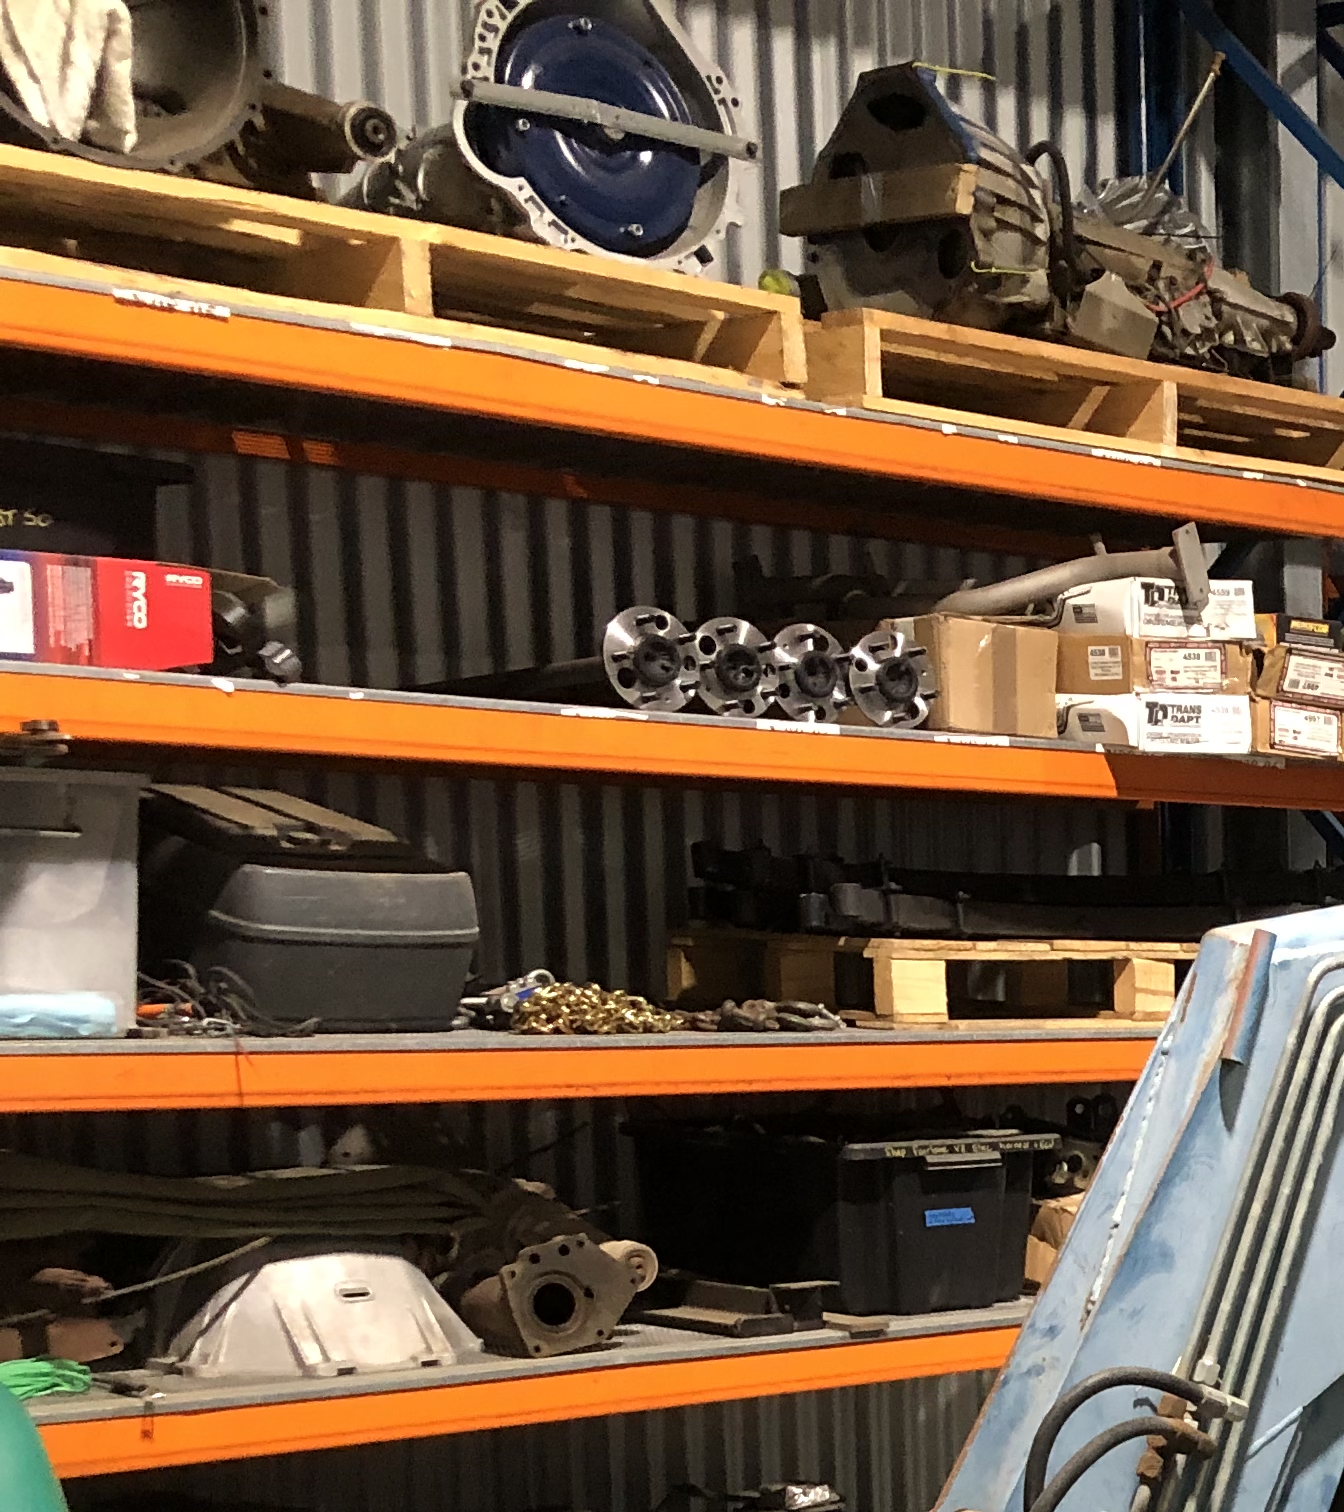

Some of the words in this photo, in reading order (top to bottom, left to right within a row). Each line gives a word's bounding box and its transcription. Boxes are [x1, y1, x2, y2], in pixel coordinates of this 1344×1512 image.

[131, 571, 148, 629] RYCO
[1168, 704, 1202, 715] TRANS
[1170, 715, 1202, 724] DAPT
